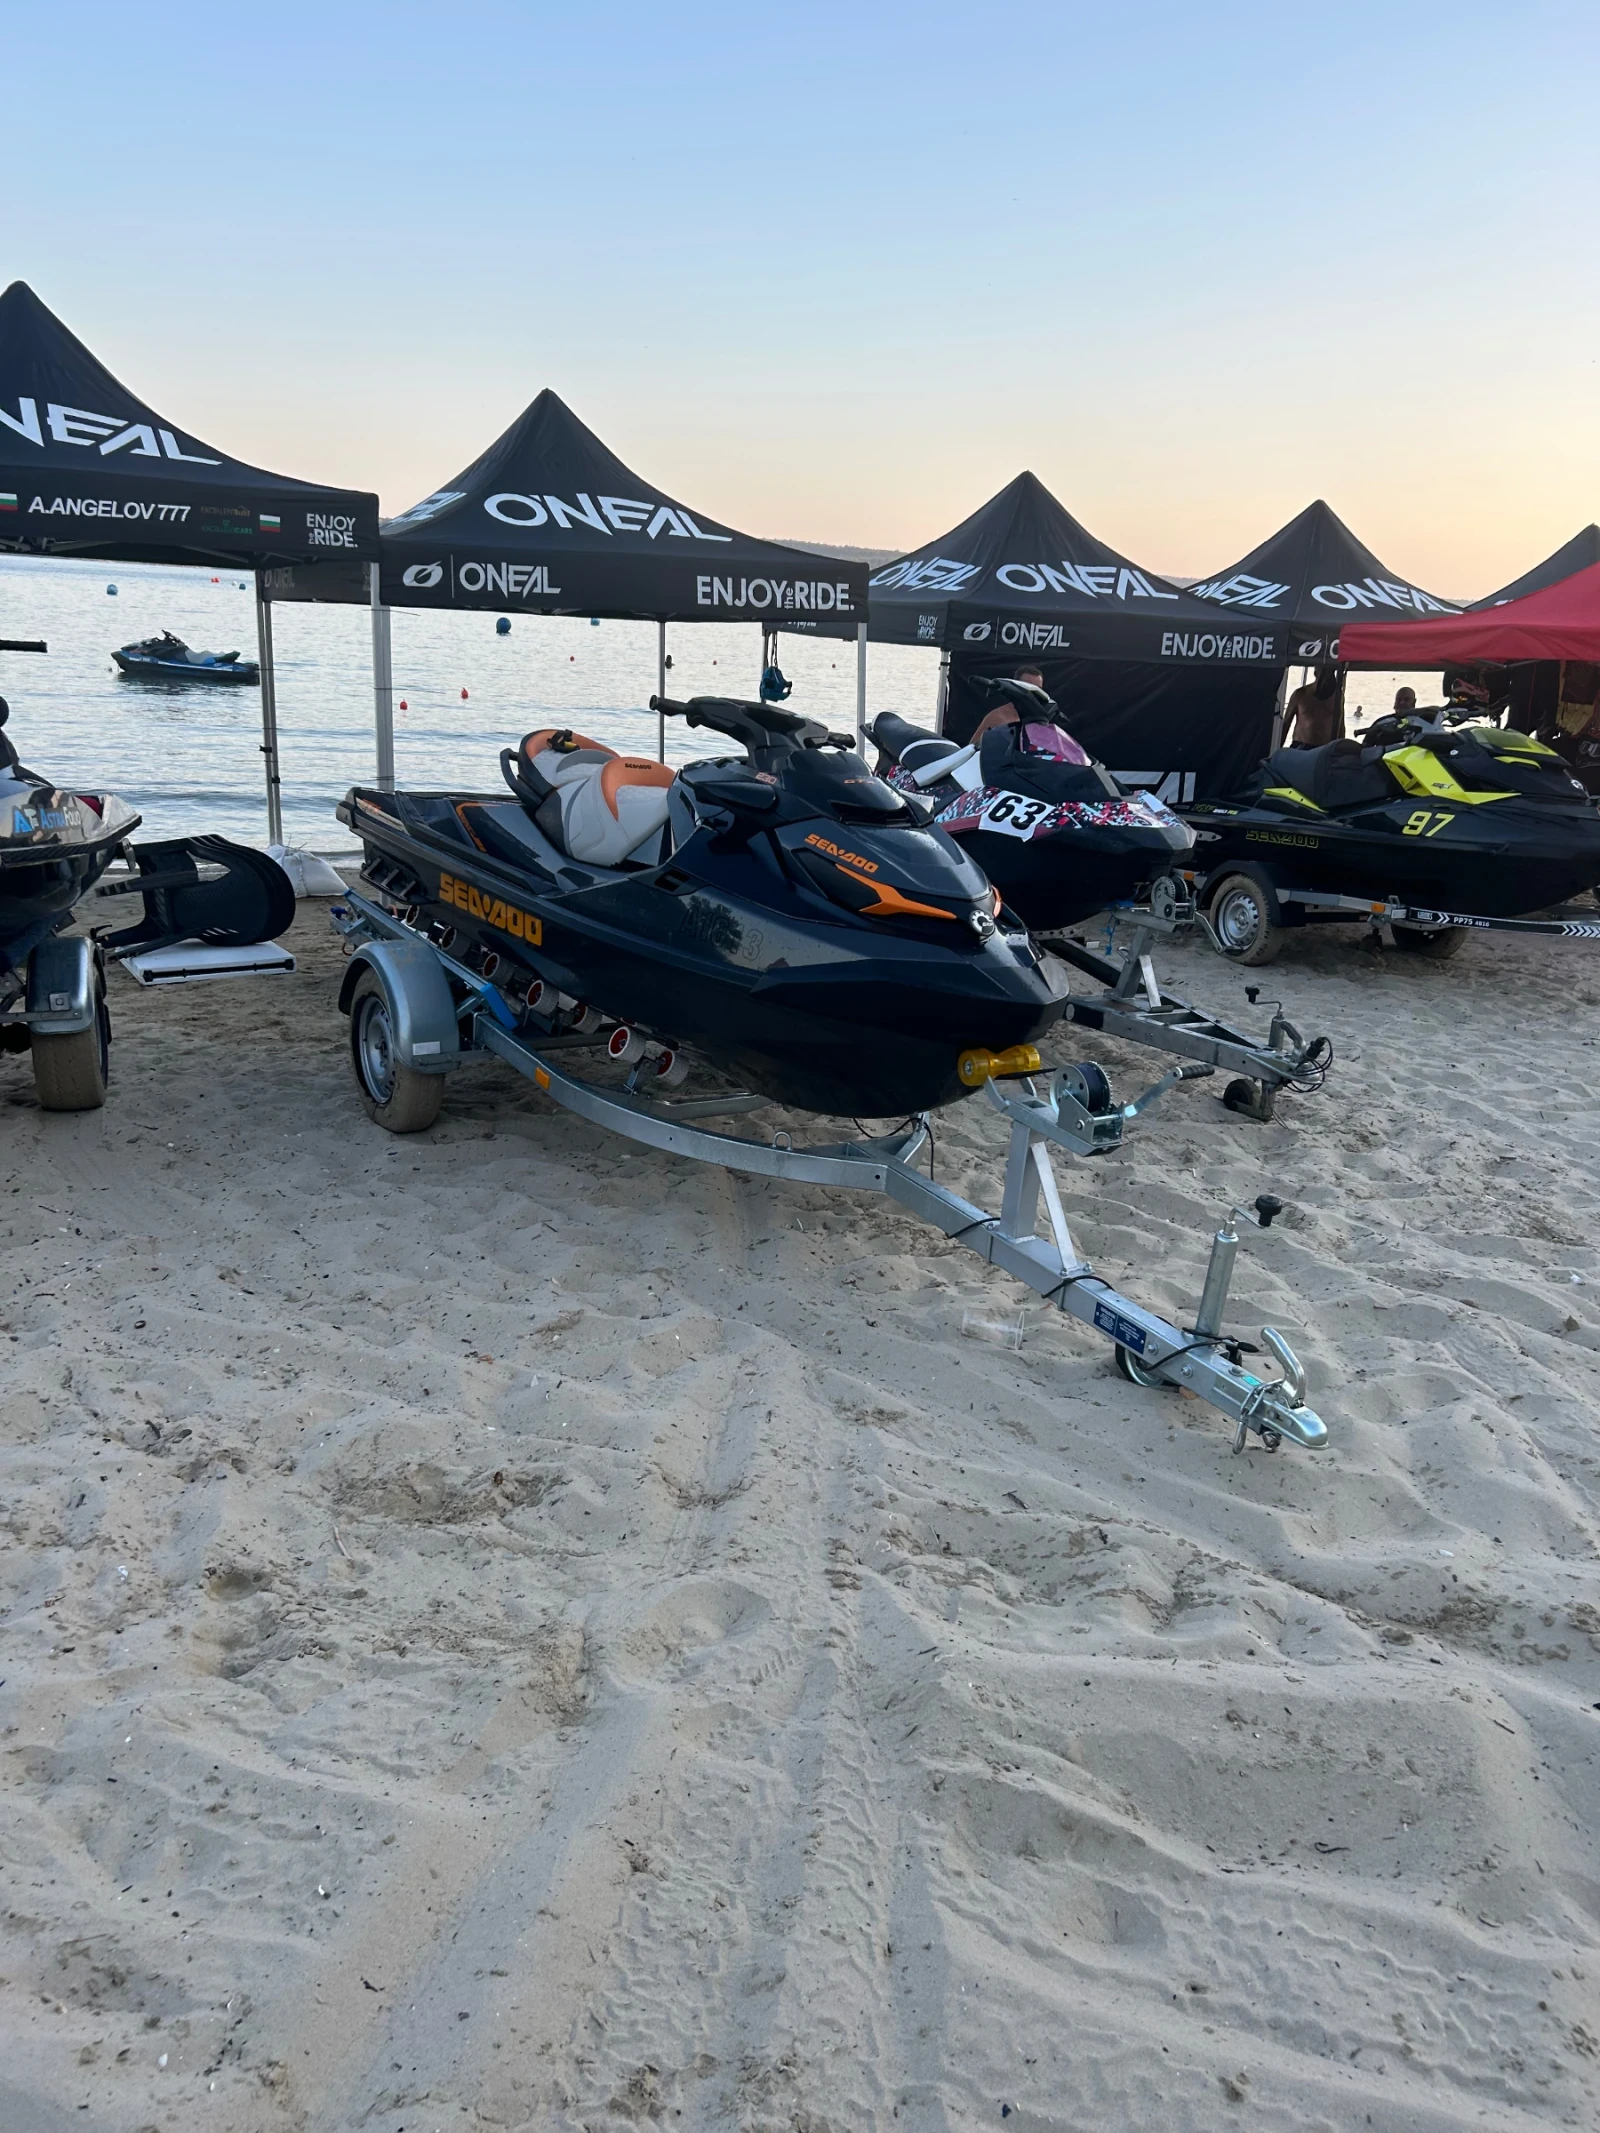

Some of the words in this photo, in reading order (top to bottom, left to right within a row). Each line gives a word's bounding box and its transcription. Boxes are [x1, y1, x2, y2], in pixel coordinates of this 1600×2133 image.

[28, 495, 155, 521] A.ANGELOV
[157, 504, 191, 522] 777
[306, 513, 356, 531] ENJOY
[697, 575, 785, 609] ENJOY
[1161, 632, 1225, 658] ENJOY
[754, 771, 777, 785] 230
[988, 795, 1047, 830] 63
[1402, 811, 1455, 837] 97
[1453, 916, 1473, 926] PP75
